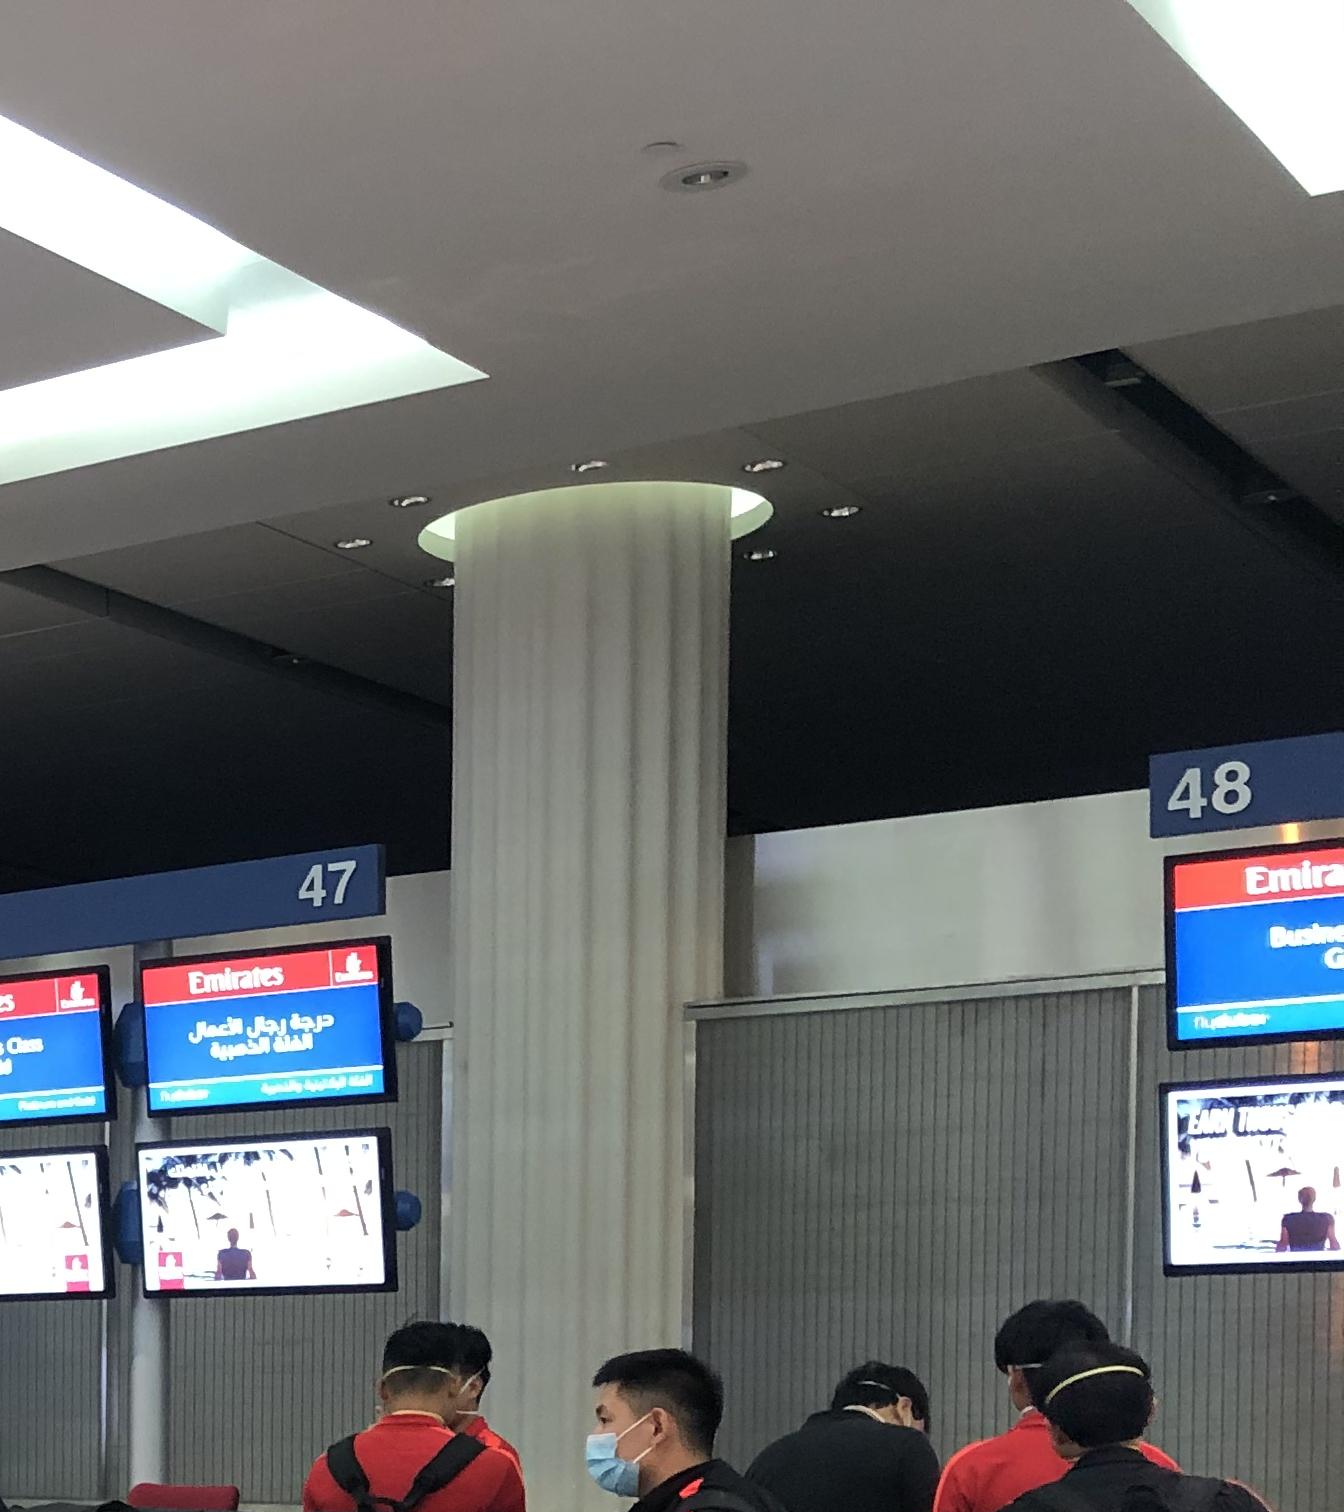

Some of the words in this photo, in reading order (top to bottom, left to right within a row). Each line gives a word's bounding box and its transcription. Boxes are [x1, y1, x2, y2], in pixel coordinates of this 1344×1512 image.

[1166, 760, 1252, 819] 48
[298, 860, 358, 907] 47
[187, 965, 285, 995] Emirates
[6, 1036, 44, 1055] Class
